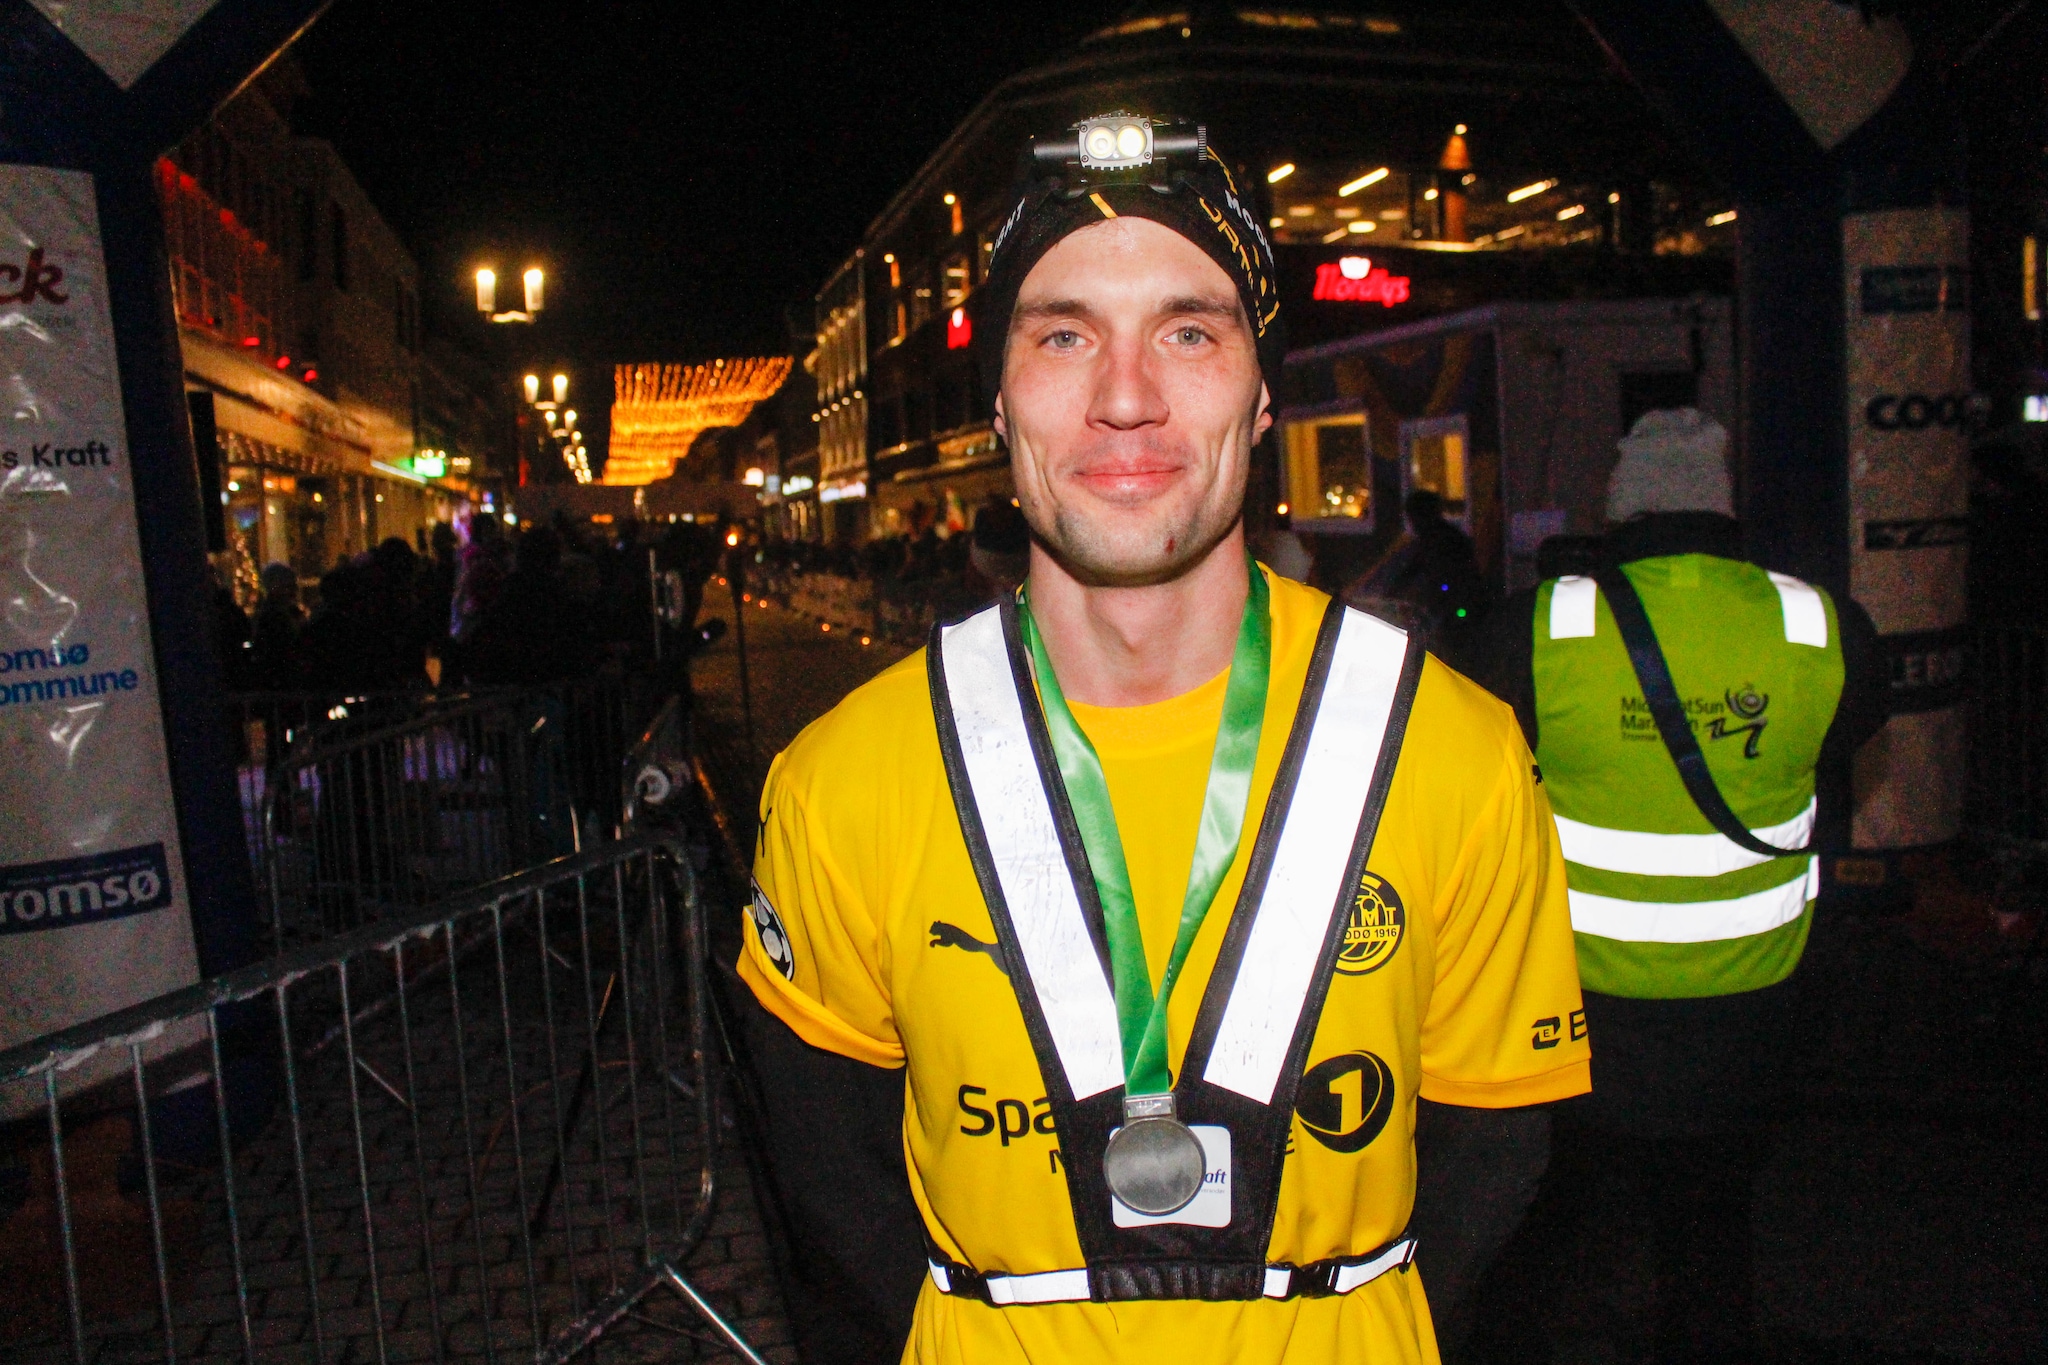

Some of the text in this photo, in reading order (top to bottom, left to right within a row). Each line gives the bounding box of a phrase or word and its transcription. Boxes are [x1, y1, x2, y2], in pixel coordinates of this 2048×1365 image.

[32, 440, 112, 469] Kraft
[1375, 927, 1397, 938] 1916
[958, 1084, 1058, 1147] Spa
